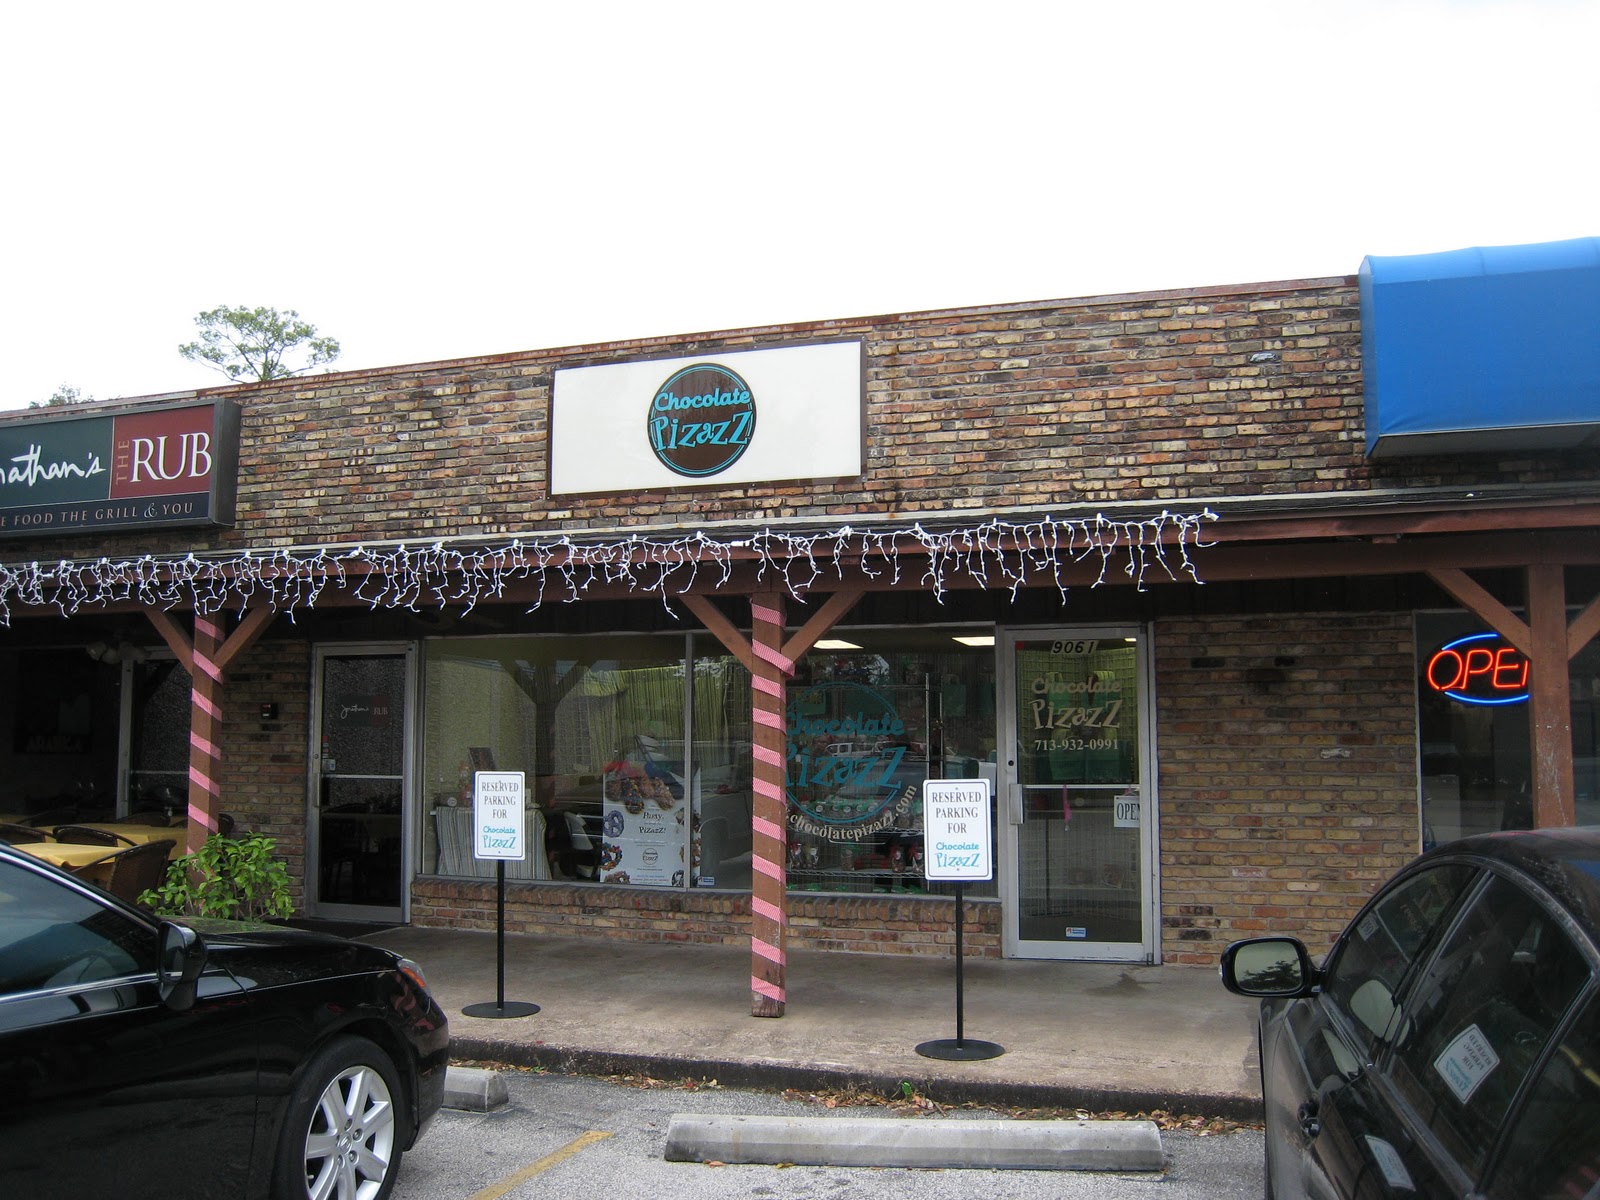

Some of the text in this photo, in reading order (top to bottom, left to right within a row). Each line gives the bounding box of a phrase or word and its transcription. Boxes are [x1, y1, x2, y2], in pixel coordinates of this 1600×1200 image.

[654, 387, 751, 412] Chocolate
[116, 440, 130, 485] THE
[129, 432, 213, 483] RUB
[14, 512, 54, 526] FOOD
[61, 510, 88, 522] THE
[95, 506, 138, 520] GRILL
[143, 502, 158, 518] &
[162, 502, 194, 515] YOU
[1053, 641, 1095, 654] 9061
[1427, 648, 1530, 691] OPE
[1031, 675, 1122, 694] Chocolate
[1034, 738, 1119, 751] 713-932-0991
[481, 781, 519, 792] RESERVED
[484, 795, 516, 806] PARKING
[932, 791, 982, 803] RESERVED
[492, 809, 507, 819] FOR
[935, 807, 979, 819] PARKING
[483, 825, 516, 834] Chocolate
[947, 822, 967, 834] FOR
[935, 842, 980, 851] Chocolate
